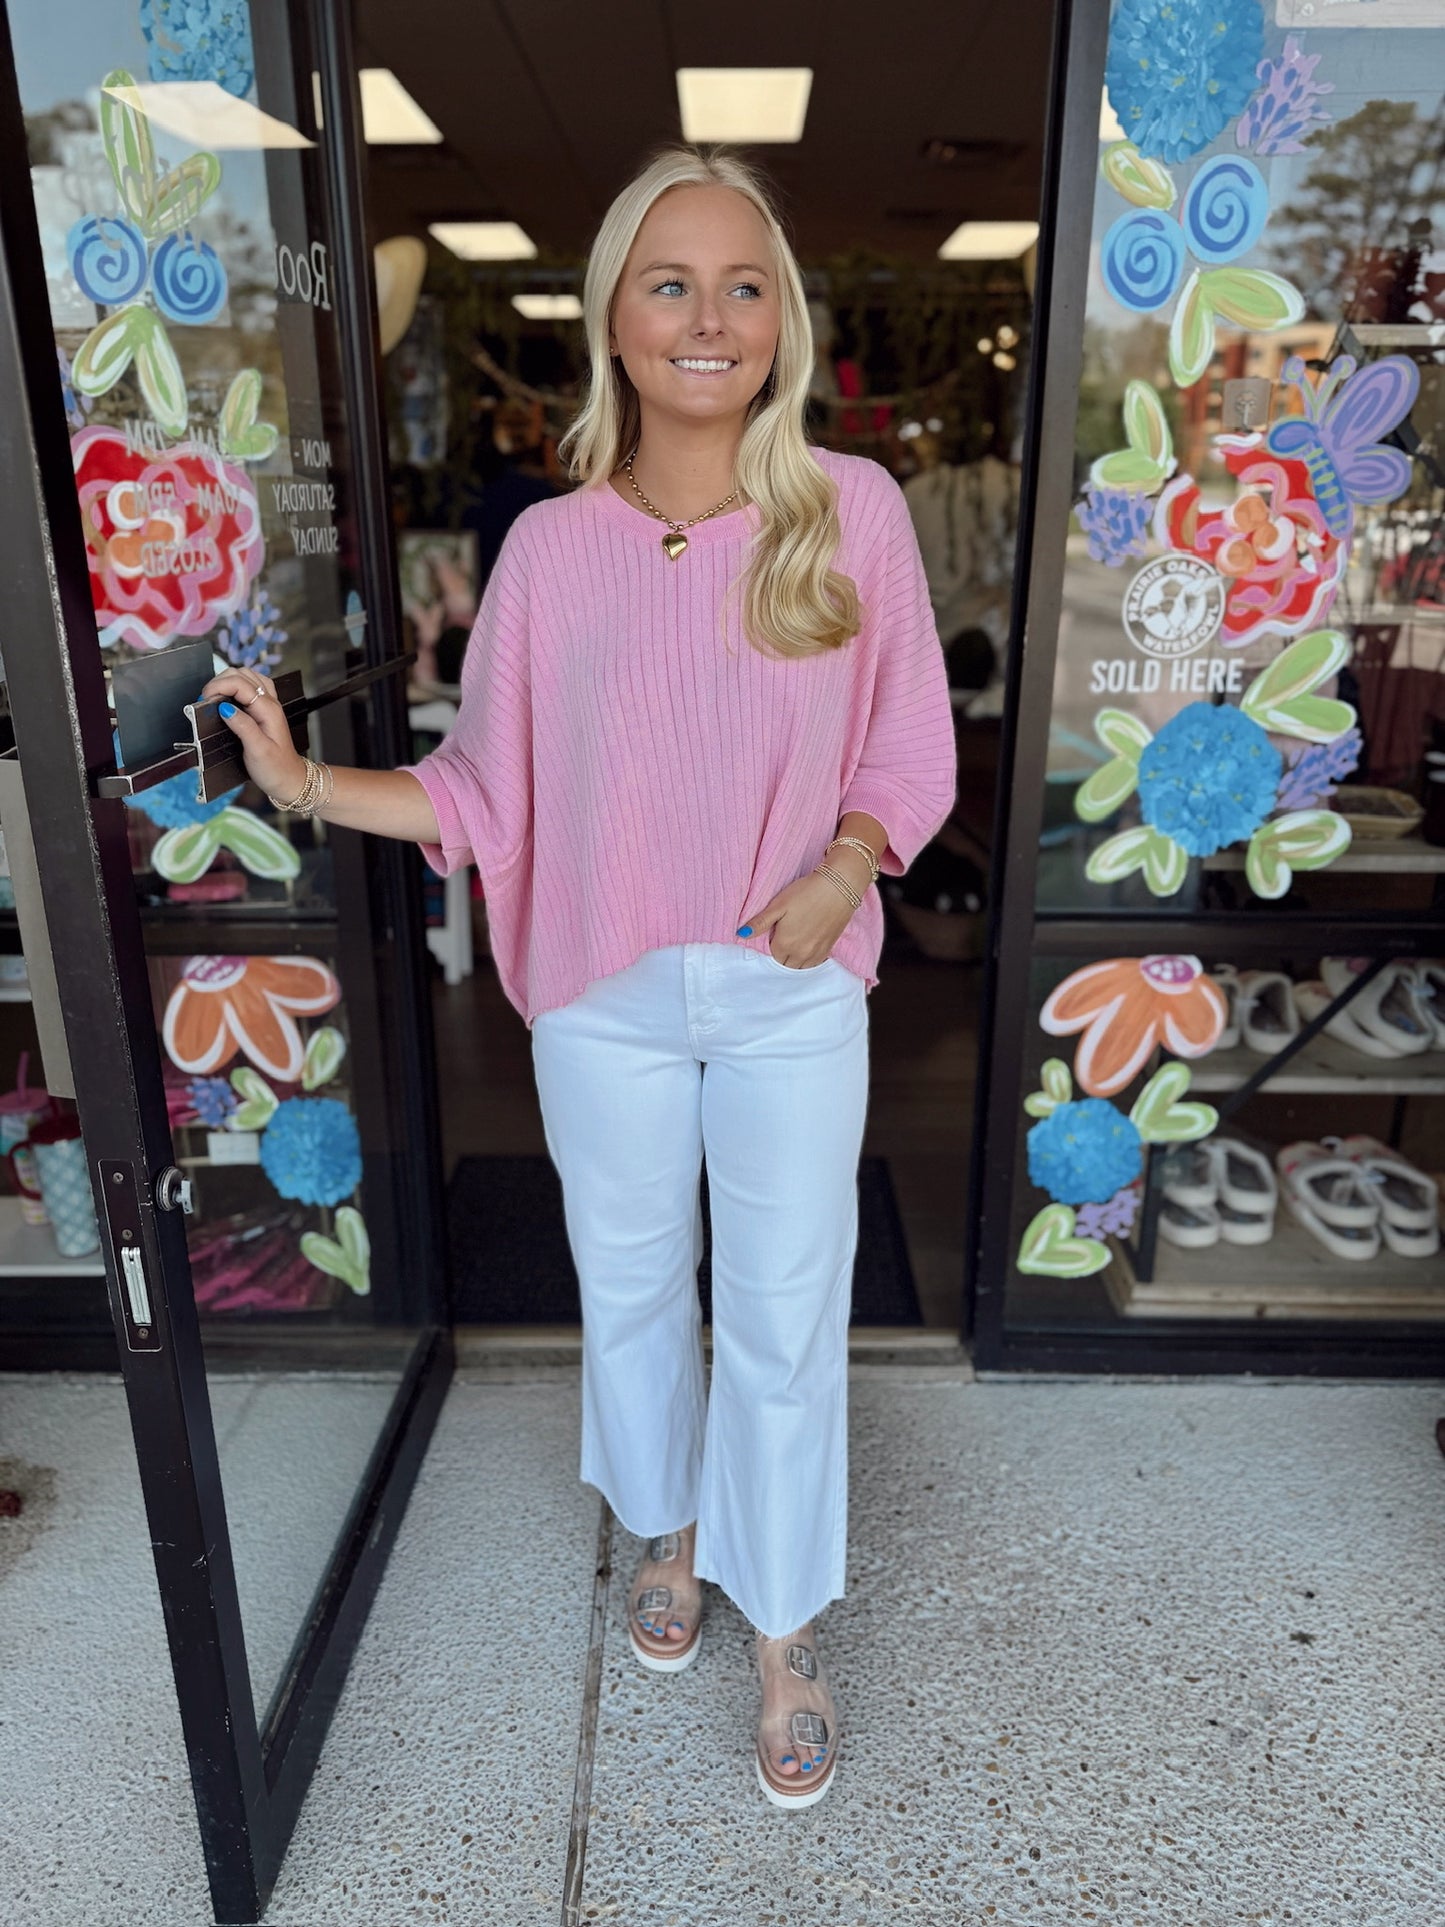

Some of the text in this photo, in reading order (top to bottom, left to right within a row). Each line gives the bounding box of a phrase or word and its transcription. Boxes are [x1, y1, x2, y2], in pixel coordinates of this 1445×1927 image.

[1128, 566, 1164, 622] PRAIRIE
[1143, 604, 1220, 653] WATERFOWL
[1090, 658, 1245, 693] SOLD HERE
